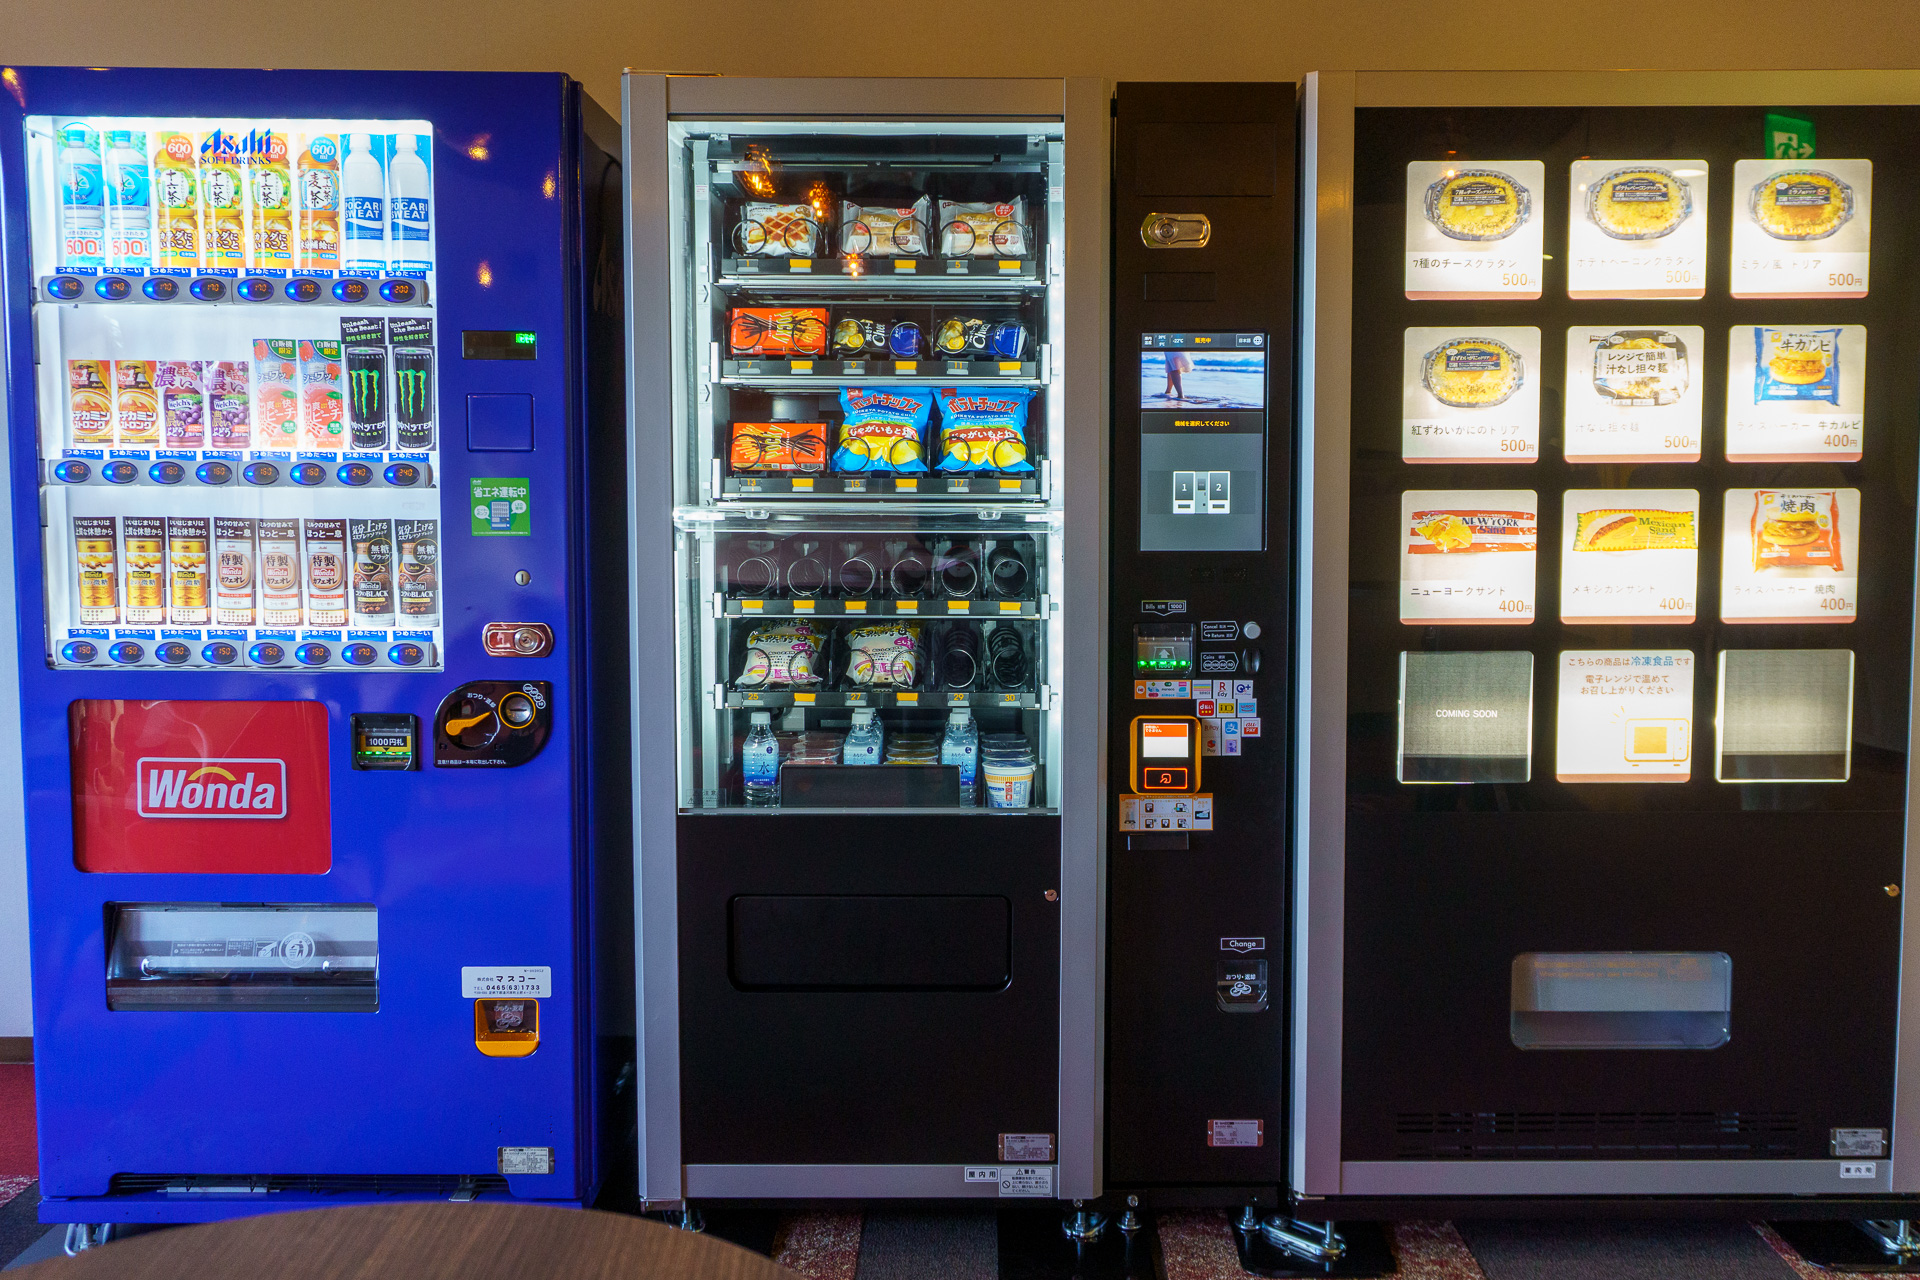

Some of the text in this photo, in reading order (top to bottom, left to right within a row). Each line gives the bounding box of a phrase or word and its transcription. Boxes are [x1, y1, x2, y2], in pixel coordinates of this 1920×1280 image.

[200, 128, 272, 154] Asahi
[168, 144, 191, 154] 600
[312, 145, 334, 155] 600
[200, 156, 272, 165] SOFT DRINKS
[165, 170, 180, 206] 十六茶
[212, 170, 226, 206] 十六茶
[261, 170, 275, 206] 十六茶
[308, 172, 324, 208] 麦茶
[66, 240, 97, 255] 600
[112, 240, 142, 255] 600
[342, 320, 369, 329] Unleash
[1781, 339, 1831, 352] 牛カルビ
[1608, 351, 1667, 361] レンジで簡単
[1606, 363, 1668, 374] 汁なし担々麺
[168, 399, 190, 408] Welch's
[215, 400, 237, 408] Welch's
[850, 393, 923, 414] ポテトチップス
[948, 397, 1020, 413] ポテトチップス
[267, 409, 296, 422] ピーチ
[312, 409, 342, 422] ピーチ
[1818, 420, 1861, 430] 牛カルビ
[1216, 483, 1222, 491] 2
[473, 487, 526, 498] 省エネ運転中
[1781, 500, 1815, 513] 焼肉
[1462, 517, 1519, 527] NEW YORK
[1639, 518, 1686, 528] Mexican
[260, 530, 295, 538] ほっと一息
[1479, 526, 1506, 534] Sand
[1649, 526, 1676, 535] Sand
[371, 544, 390, 554] 無糖
[417, 545, 435, 555] 無糖
[221, 554, 243, 566] 特製
[266, 556, 288, 566] 特製
[222, 567, 242, 575] Wonda
[314, 568, 334, 576] Wonda
[1814, 585, 1836, 594] 焼肉
[1499, 600, 1532, 612] 400円
[1659, 598, 1693, 610] 400円
[1568, 656, 1691, 667] こちらの商品は冷凍食品です
[1585, 674, 1670, 683] 電子レンジで温めて
[1580, 686, 1675, 695] お召し上がりください
[953, 693, 964, 702] 29
[1436, 710, 1498, 718] COMING SOON
[368, 738, 404, 746] 1000円札
[759, 762, 770, 775] 水
[149, 769, 275, 809] Wonda
